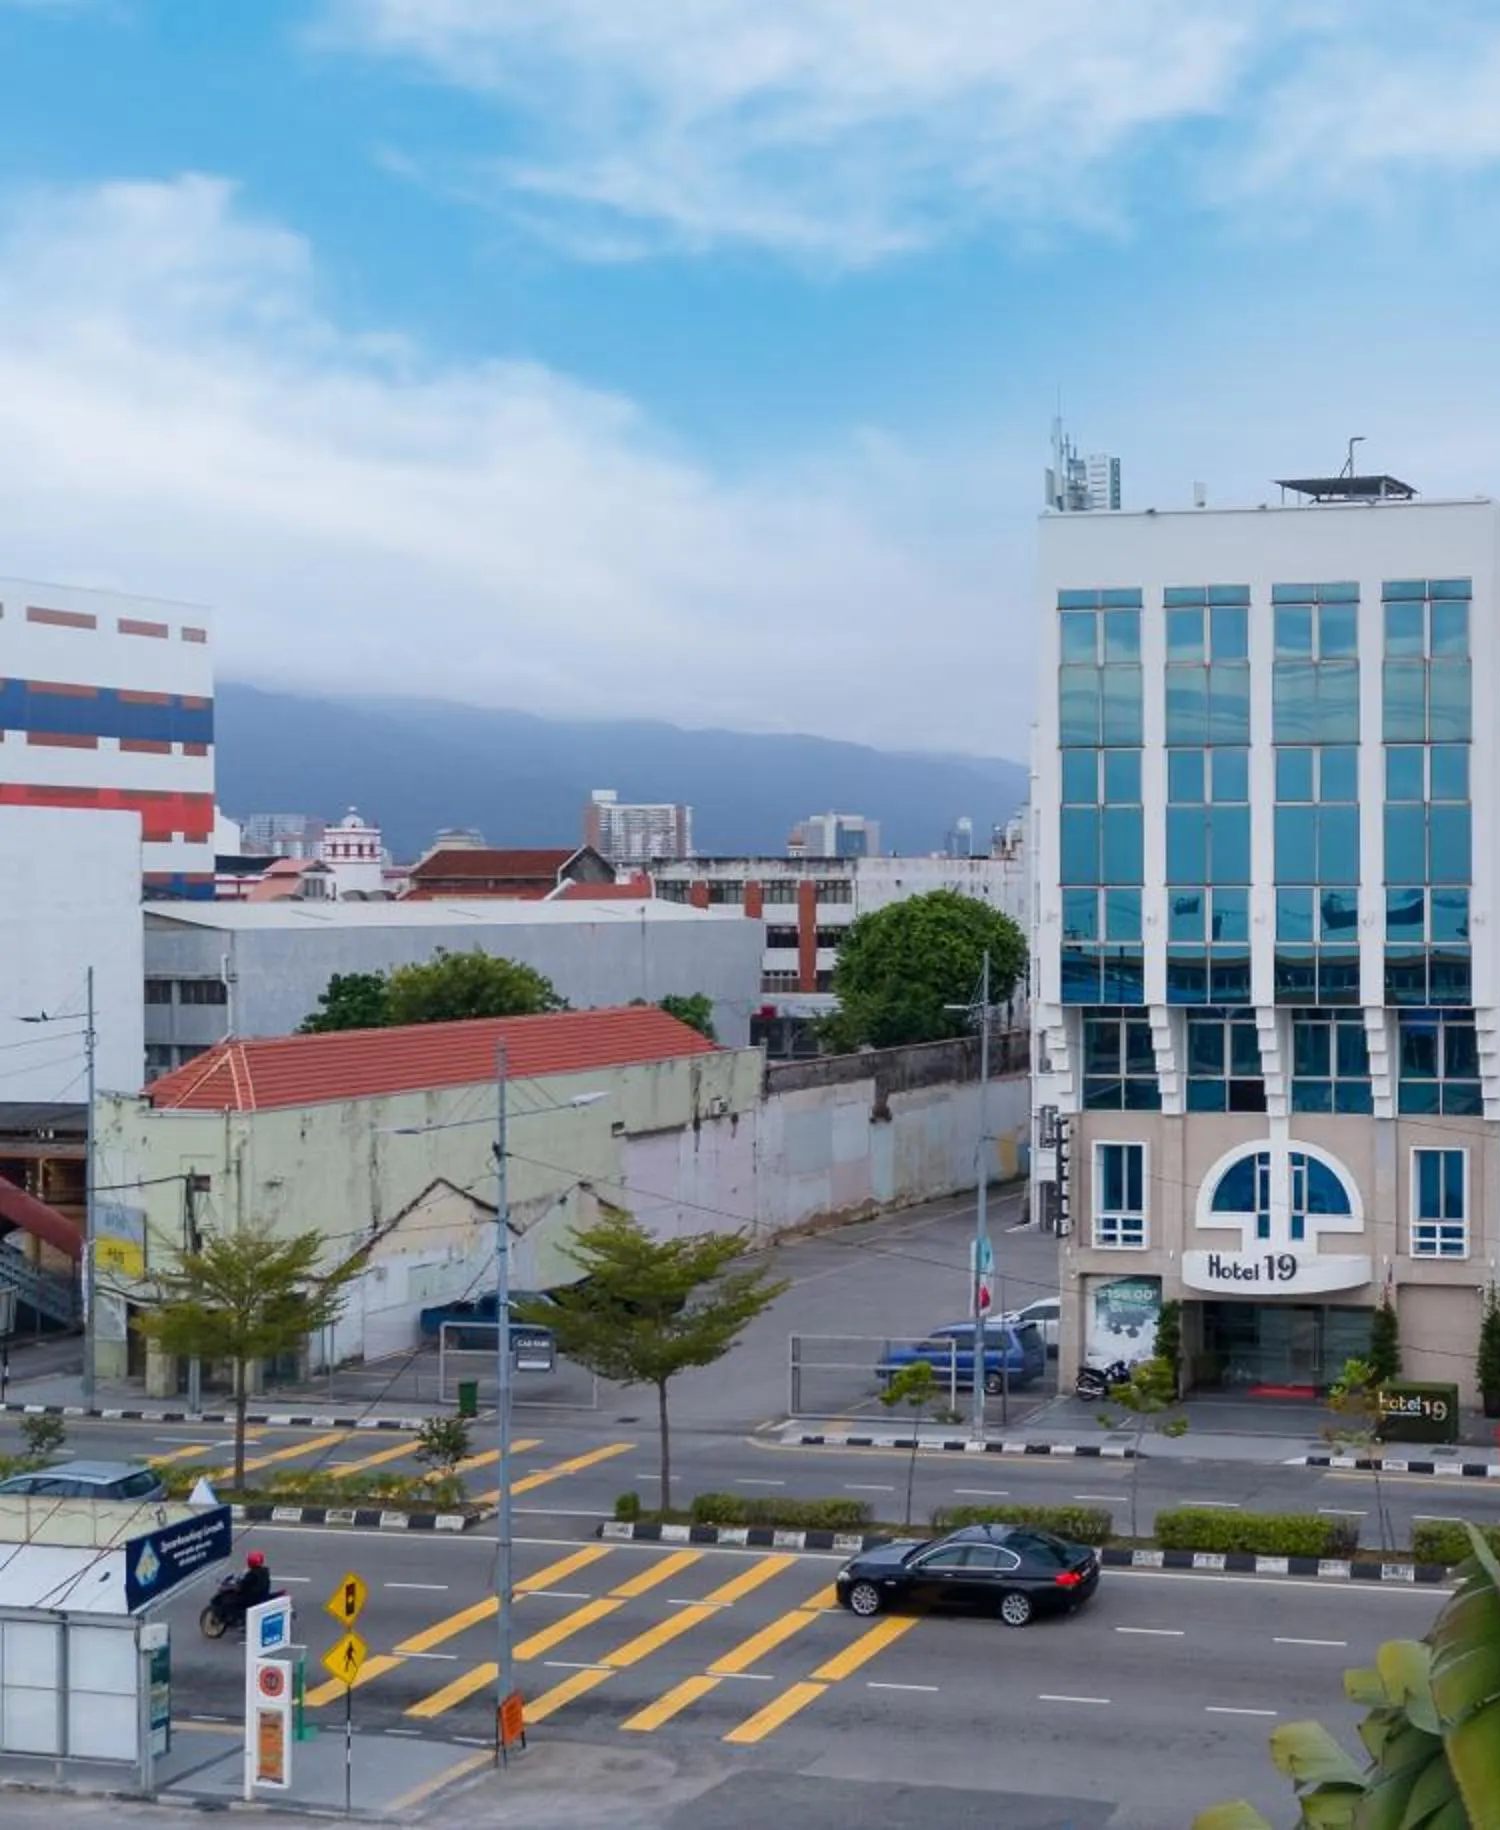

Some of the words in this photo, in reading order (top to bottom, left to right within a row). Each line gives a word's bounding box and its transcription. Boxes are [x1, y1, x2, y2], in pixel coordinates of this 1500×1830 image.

[1209, 1253, 1259, 1281] Hotel
[1264, 1253, 1297, 1281] 19
[1421, 1400, 1448, 1421] 19
